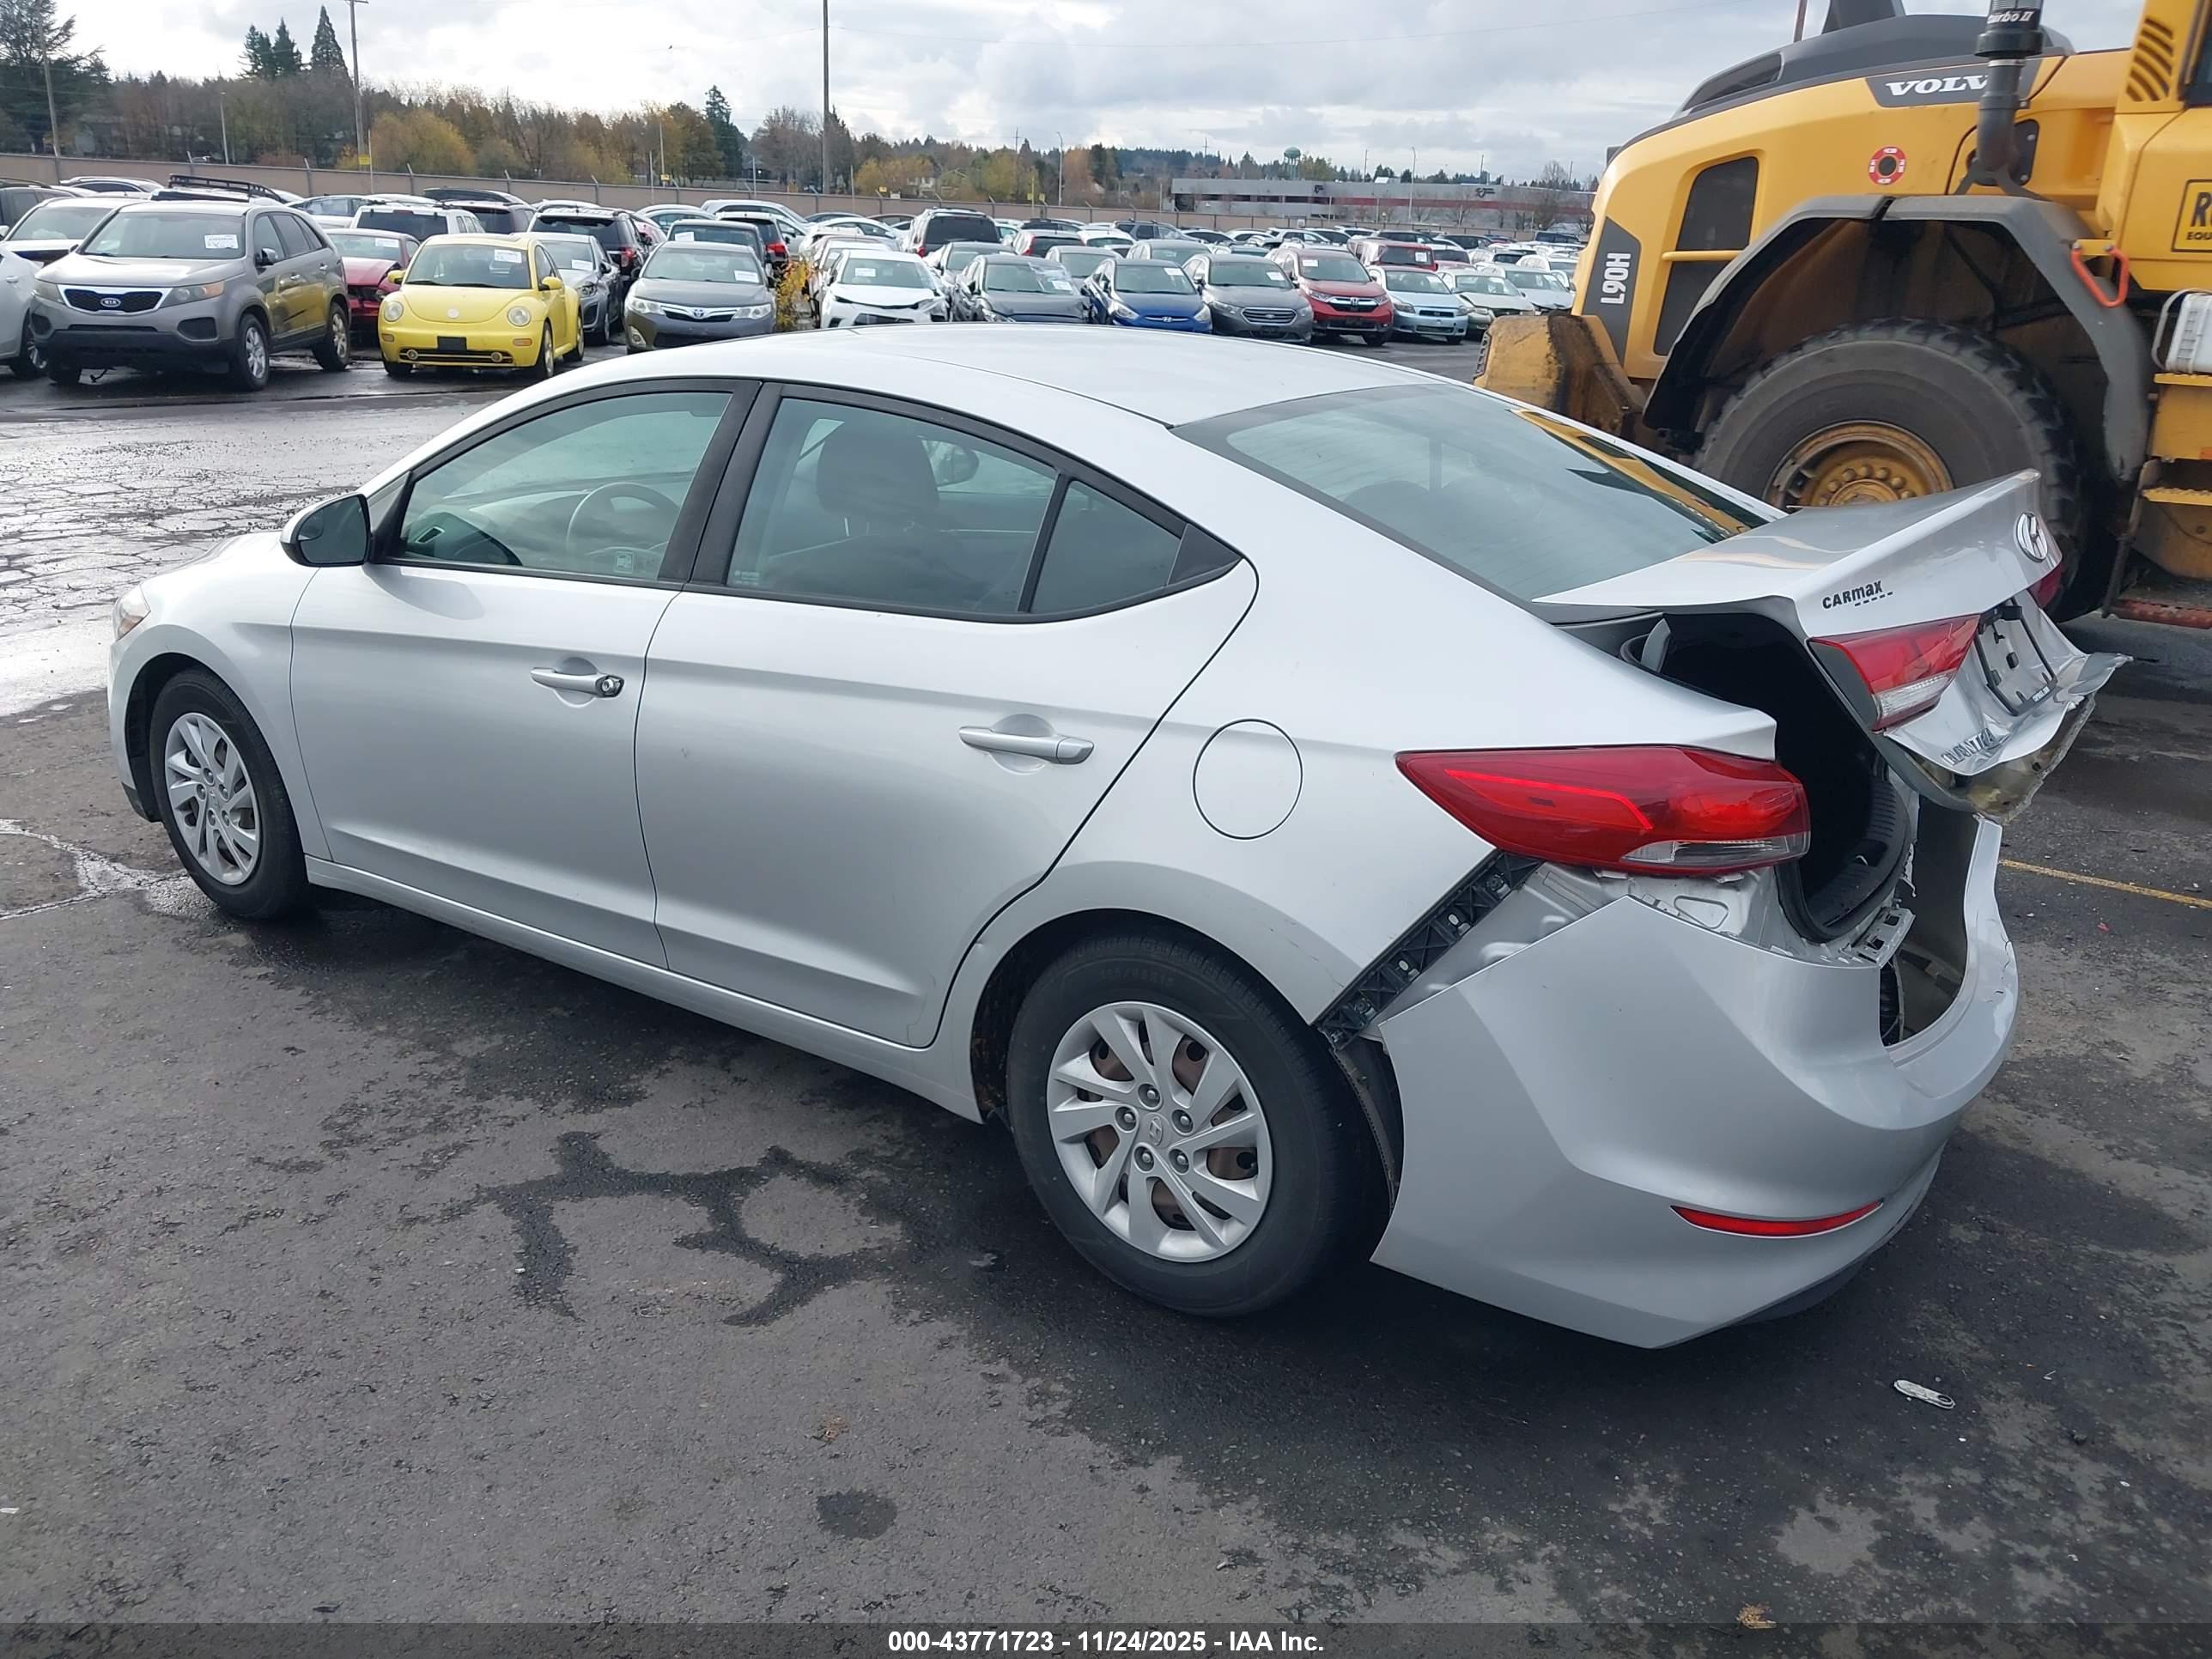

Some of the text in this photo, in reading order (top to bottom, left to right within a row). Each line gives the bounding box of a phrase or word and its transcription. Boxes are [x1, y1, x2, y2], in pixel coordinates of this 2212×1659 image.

[1886, 75, 1989, 95] VOLV
[2191, 191, 2212, 227] R
[1600, 252, 1632, 305] L90H
